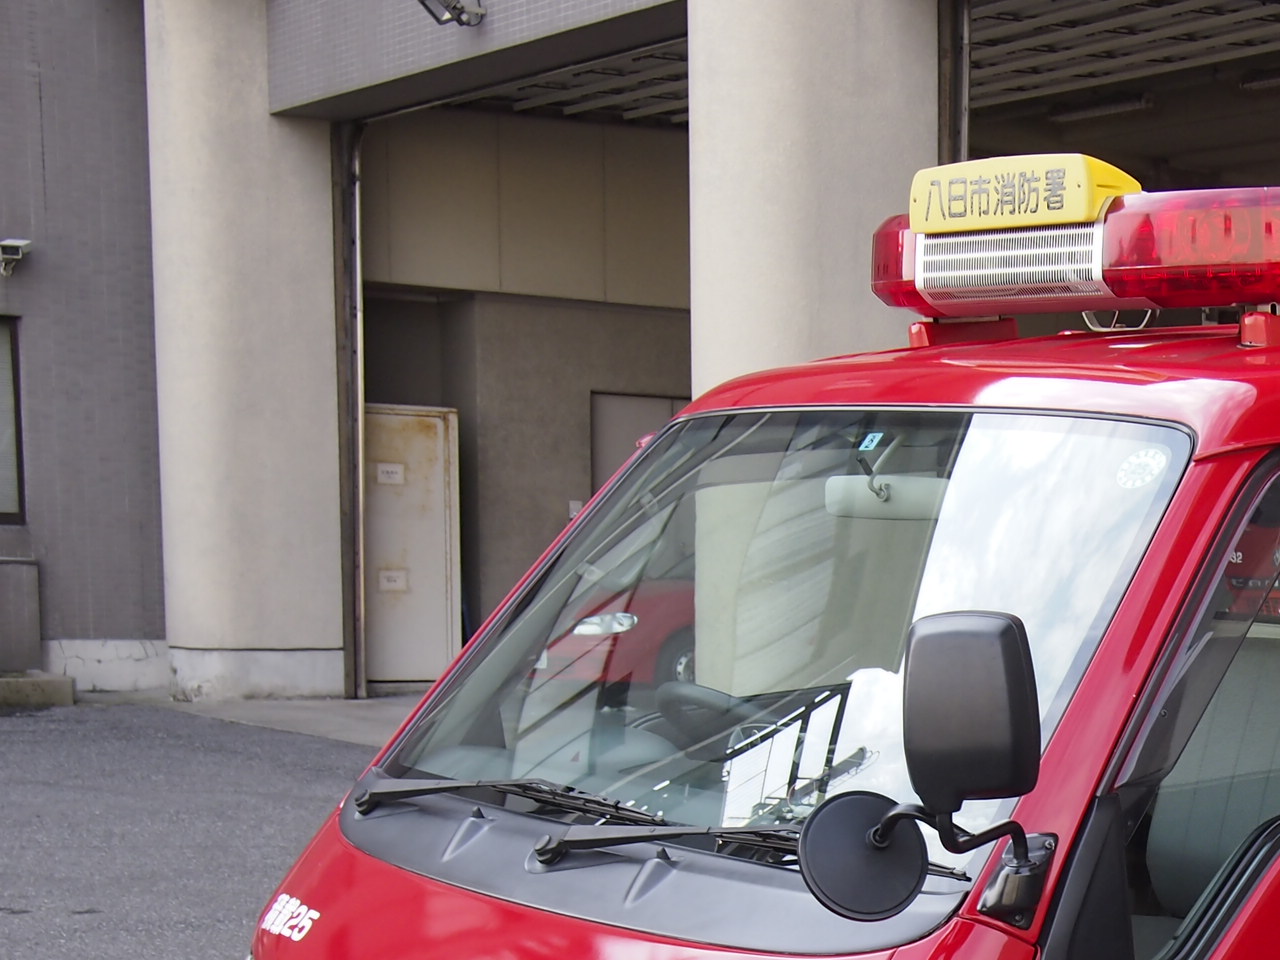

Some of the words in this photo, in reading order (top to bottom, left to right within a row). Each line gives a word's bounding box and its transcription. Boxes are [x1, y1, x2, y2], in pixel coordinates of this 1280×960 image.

[925, 168, 1066, 222] 八日市消防署
